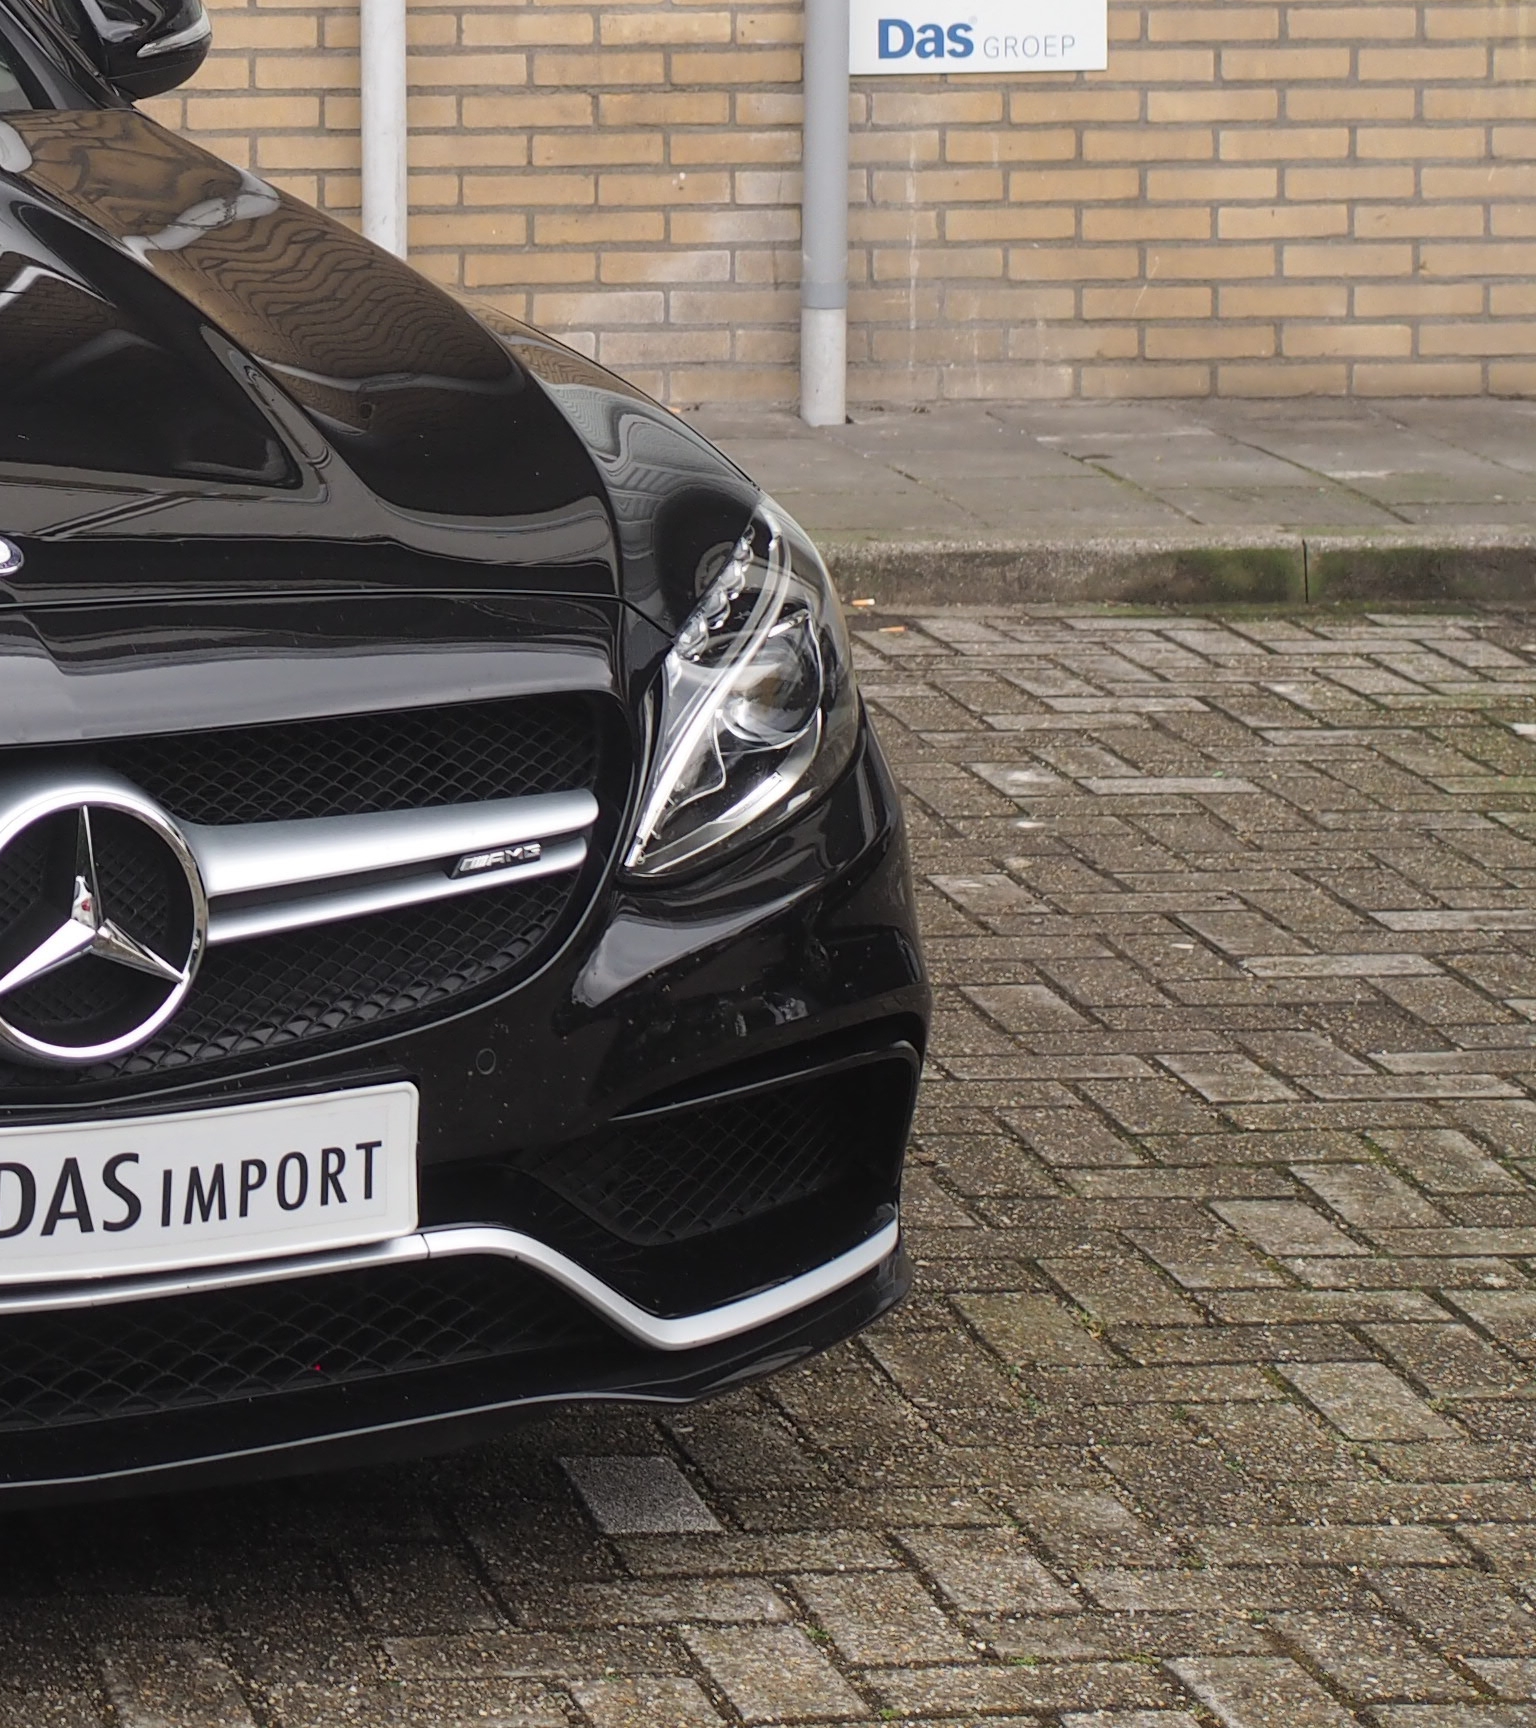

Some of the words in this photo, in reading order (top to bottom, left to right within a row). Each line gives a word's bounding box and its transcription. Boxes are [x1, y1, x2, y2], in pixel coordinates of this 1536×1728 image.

[877, 18, 974, 60] Das
[983, 34, 1076, 59] GROEP
[160, 1140, 383, 1228] IMPORT
